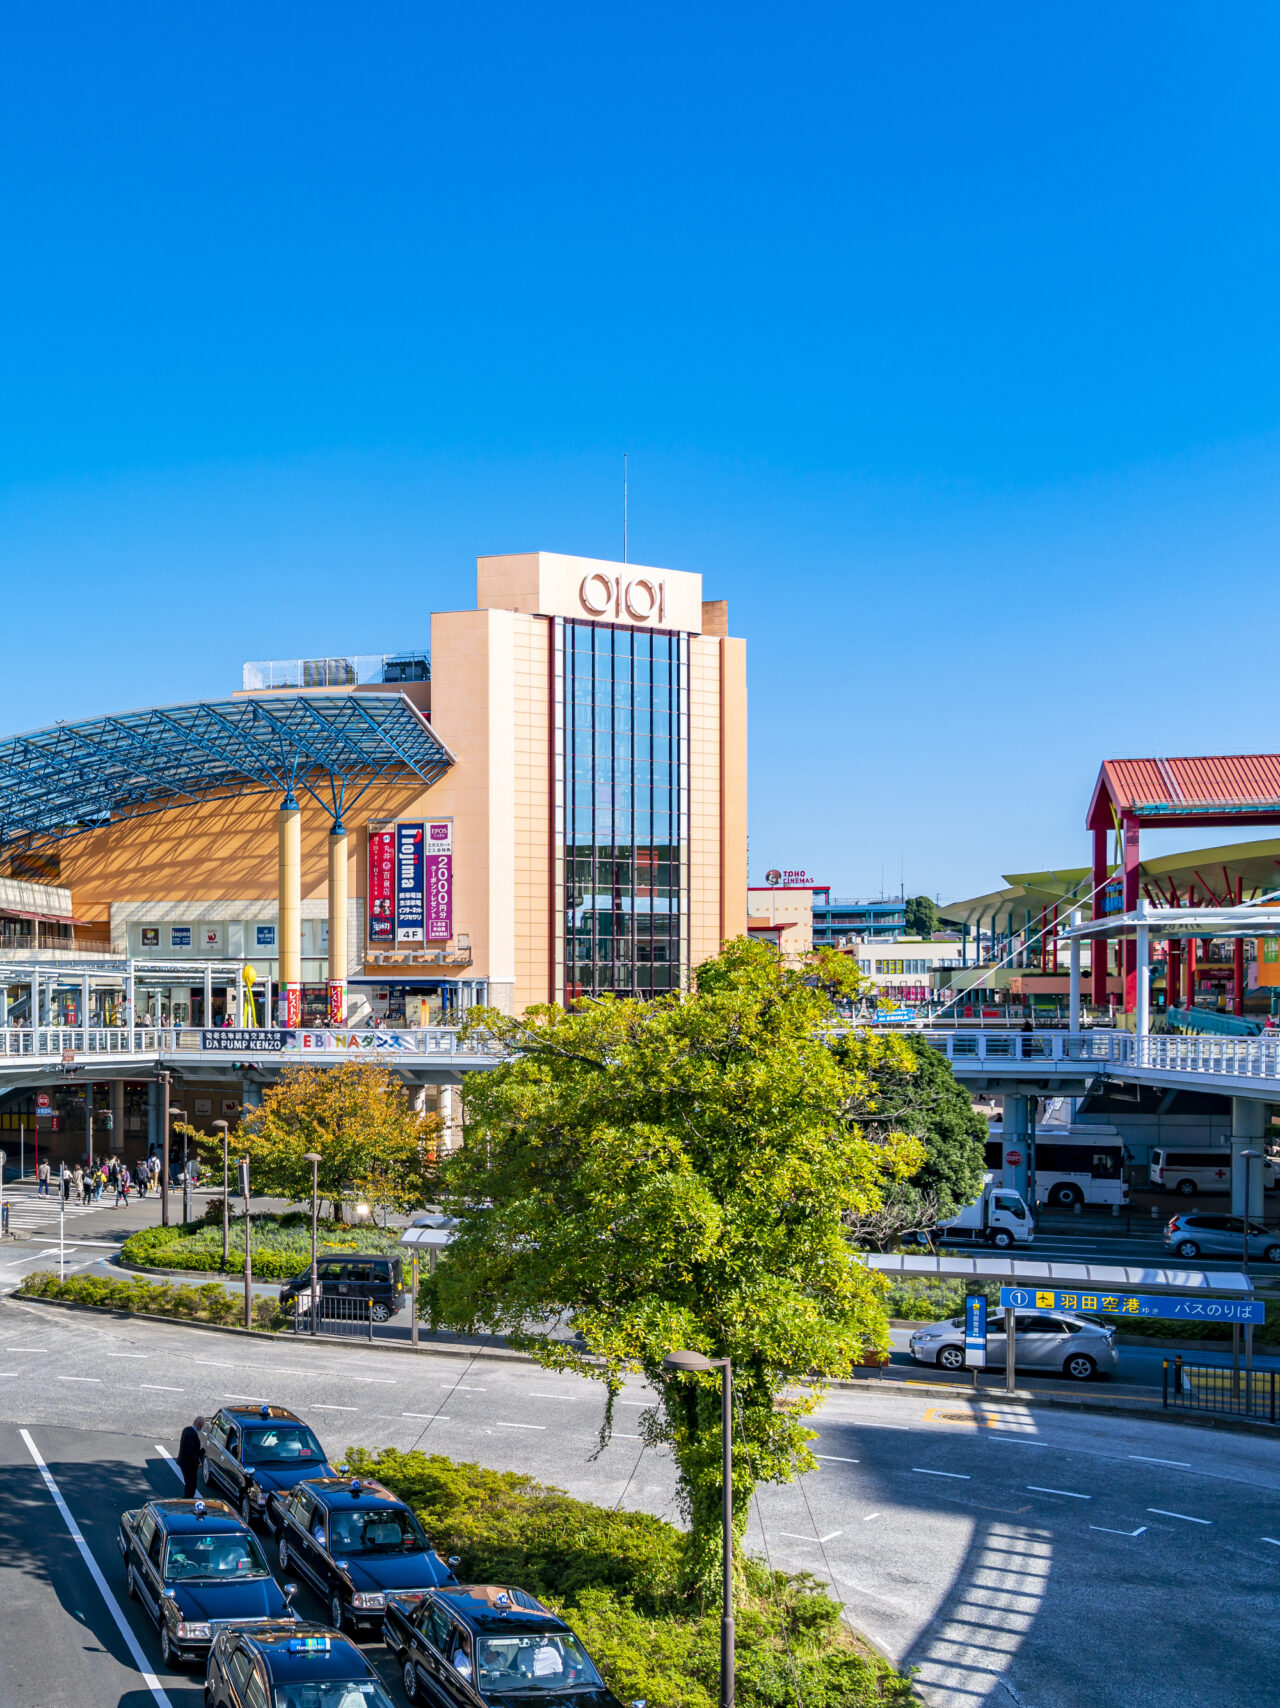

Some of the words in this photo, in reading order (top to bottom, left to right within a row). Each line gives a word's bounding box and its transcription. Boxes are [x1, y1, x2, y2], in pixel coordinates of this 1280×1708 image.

[438, 857, 448, 919] 2000円分
[206, 1040, 219, 1049] DA
[221, 1040, 248, 1049] PUMP
[250, 1040, 281, 1050] KENZO
[1060, 1294, 1141, 1314] 羽田空港
[1142, 1307, 1159, 1315] ゆき
[1175, 1303, 1252, 1318] バスのりば
